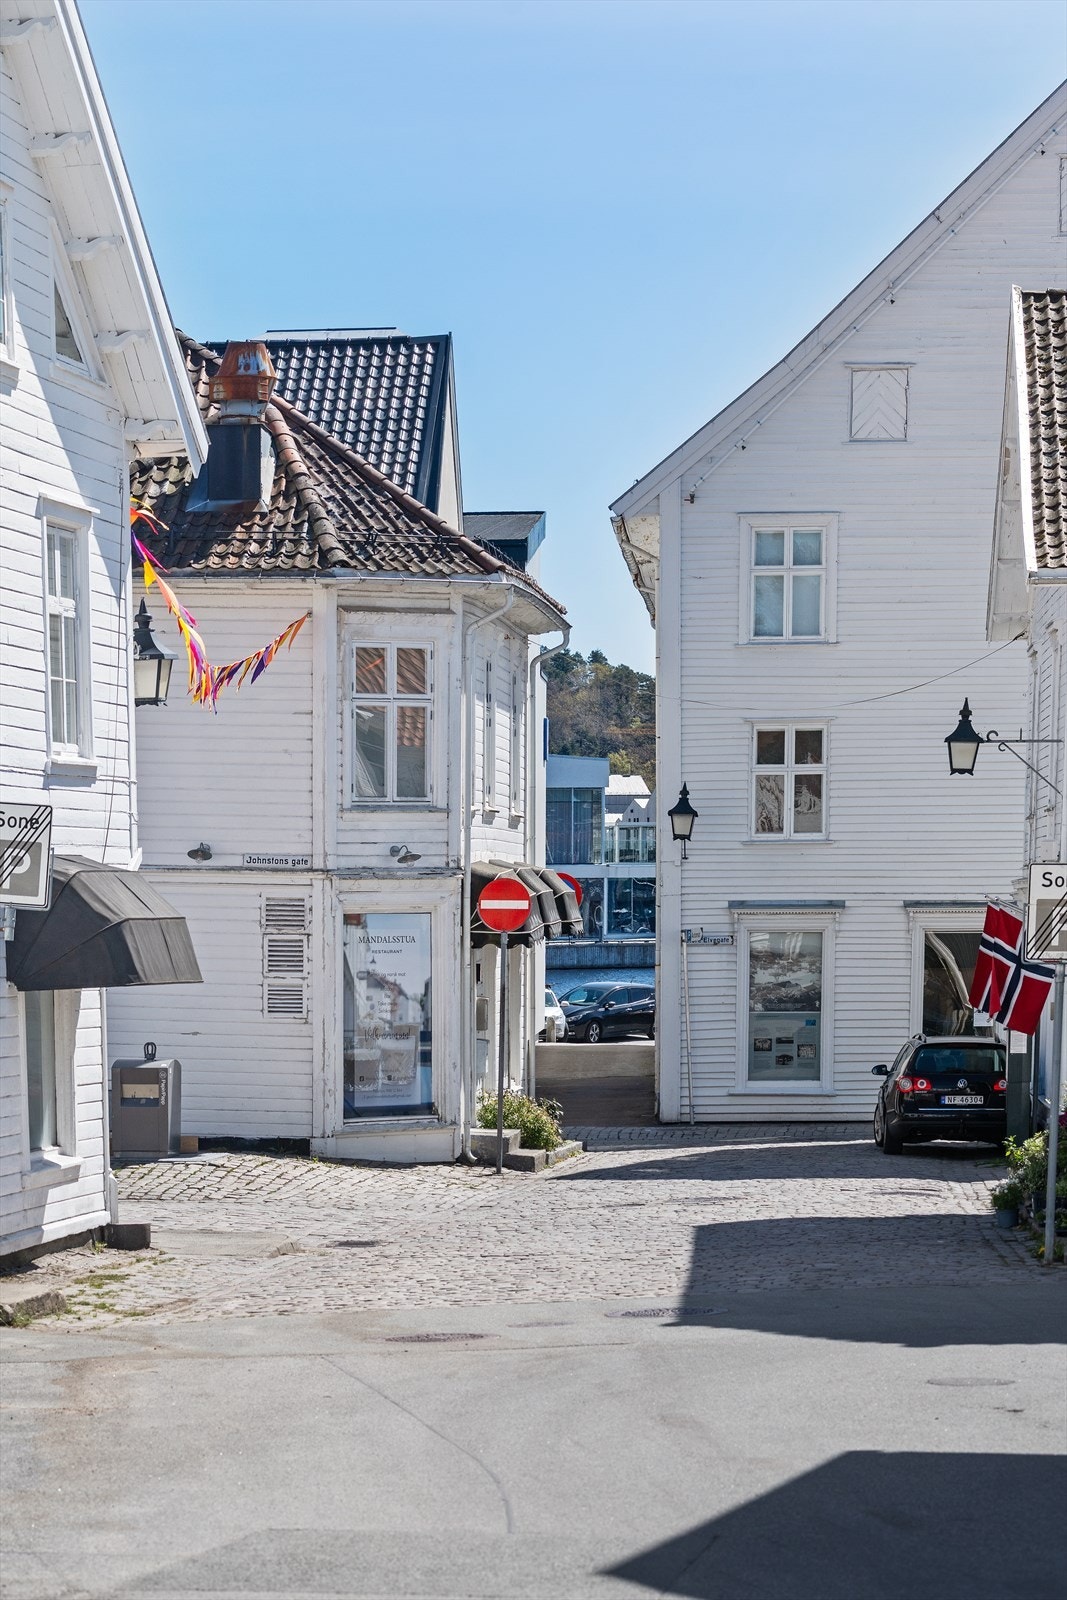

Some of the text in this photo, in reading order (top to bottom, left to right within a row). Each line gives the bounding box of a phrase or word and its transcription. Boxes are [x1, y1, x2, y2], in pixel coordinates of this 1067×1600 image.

[246, 856, 309, 867] Johnstons gate
[1042, 872, 1067, 888] So
[358, 935, 416, 944] MANDALSSTUA
[960, 1096, 983, 1104] 46304
